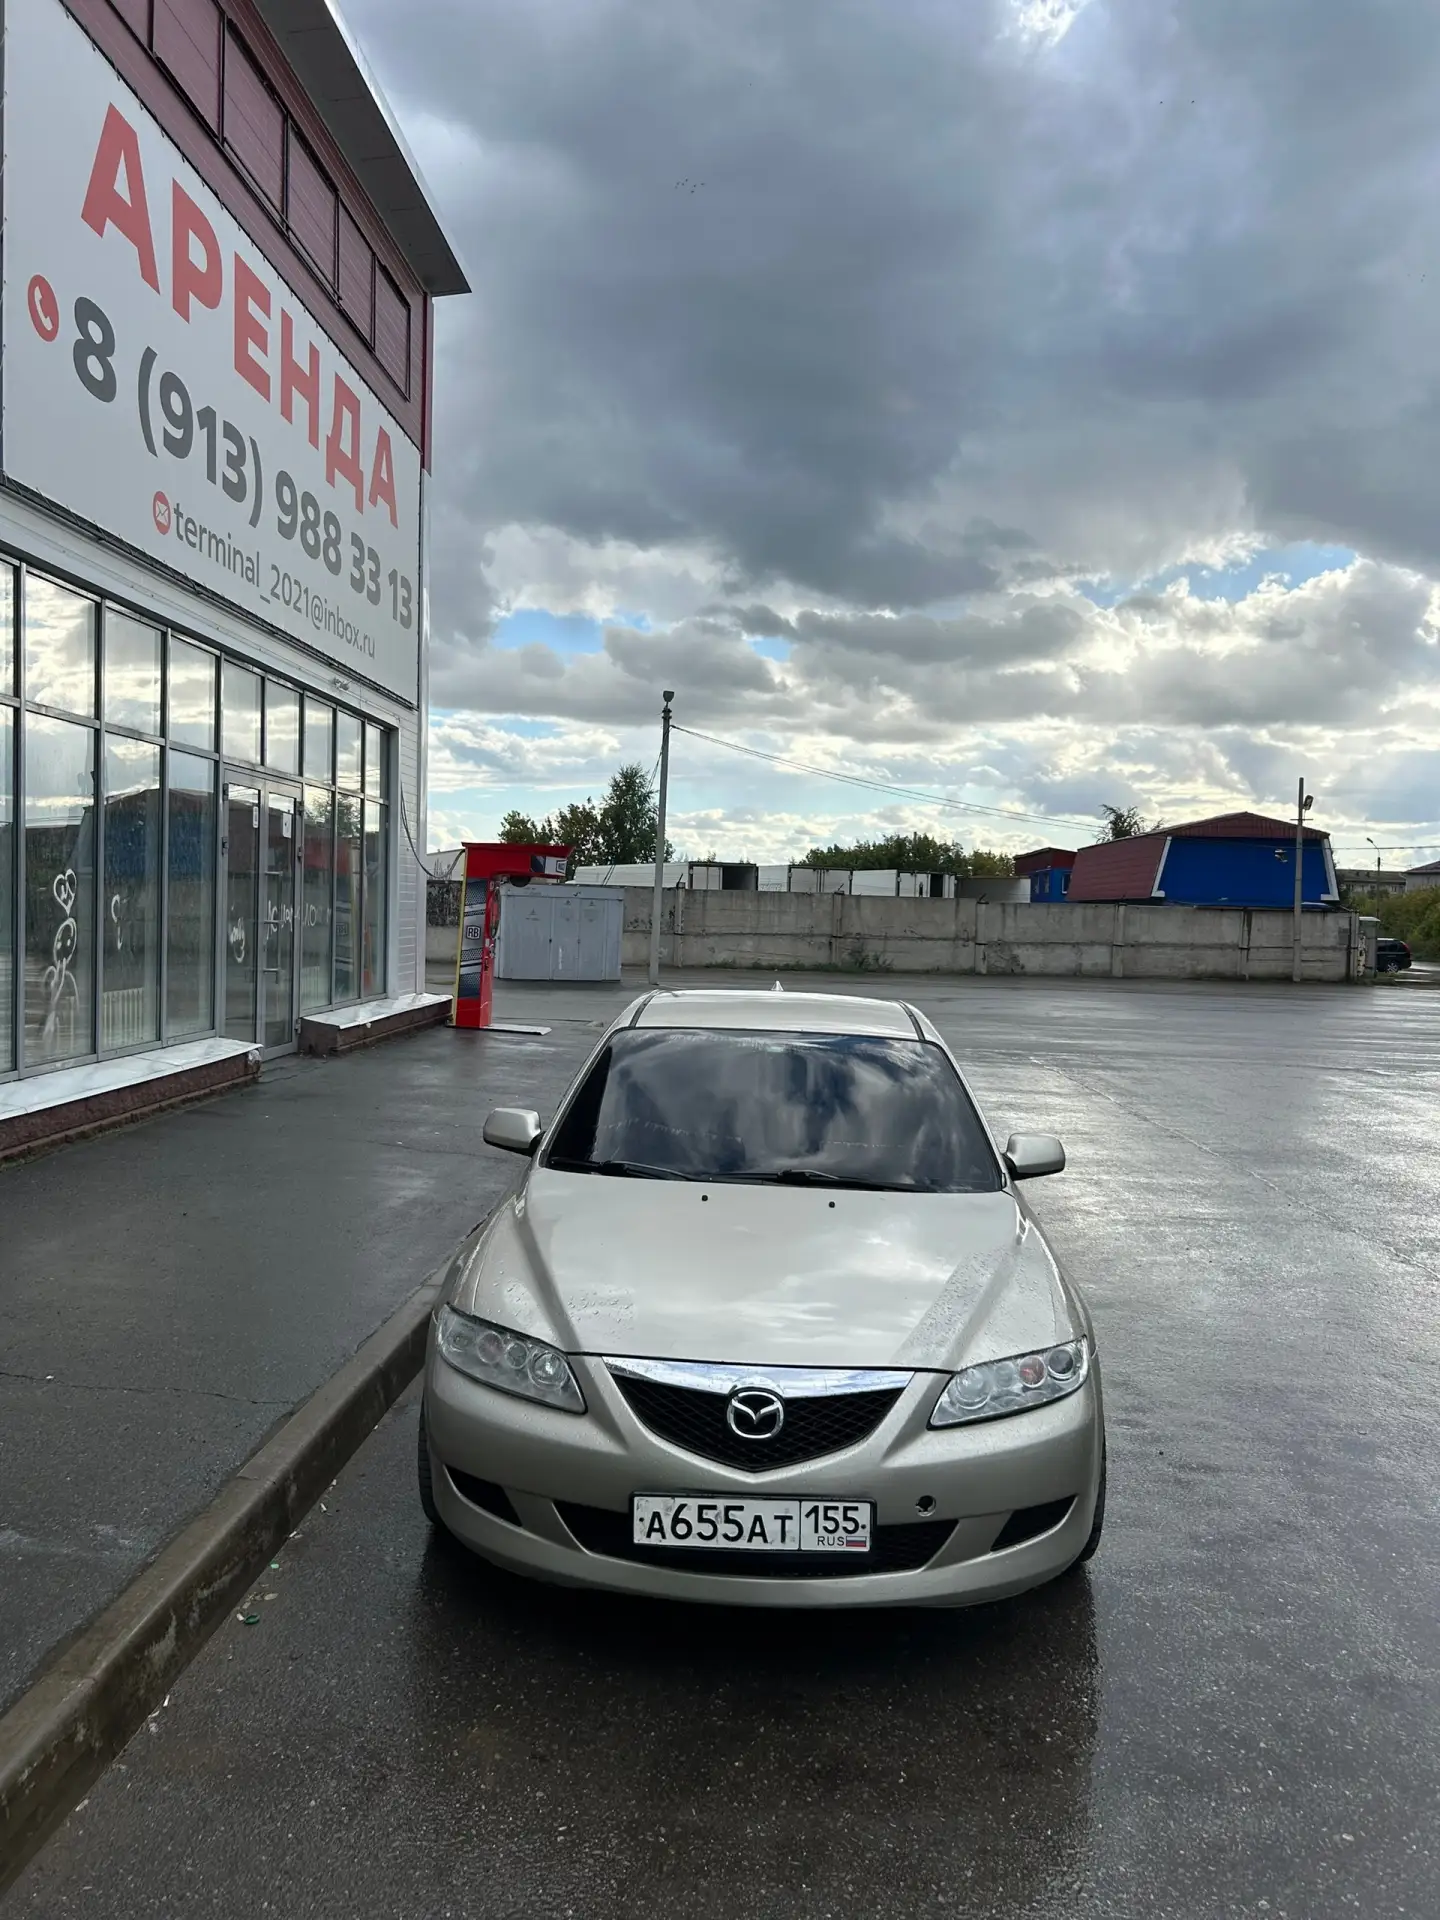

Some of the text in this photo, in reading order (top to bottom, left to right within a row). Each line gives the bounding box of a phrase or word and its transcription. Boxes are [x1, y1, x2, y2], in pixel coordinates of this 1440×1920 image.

[81, 102, 399, 528] АРЕНДА
[72, 296, 413, 630] 8 (913) 988 33 13
[173, 502, 376, 660] terminal_2021@inbox.ru
[804, 1505, 860, 1535] 155
[816, 1535, 845, 1547] RUS
